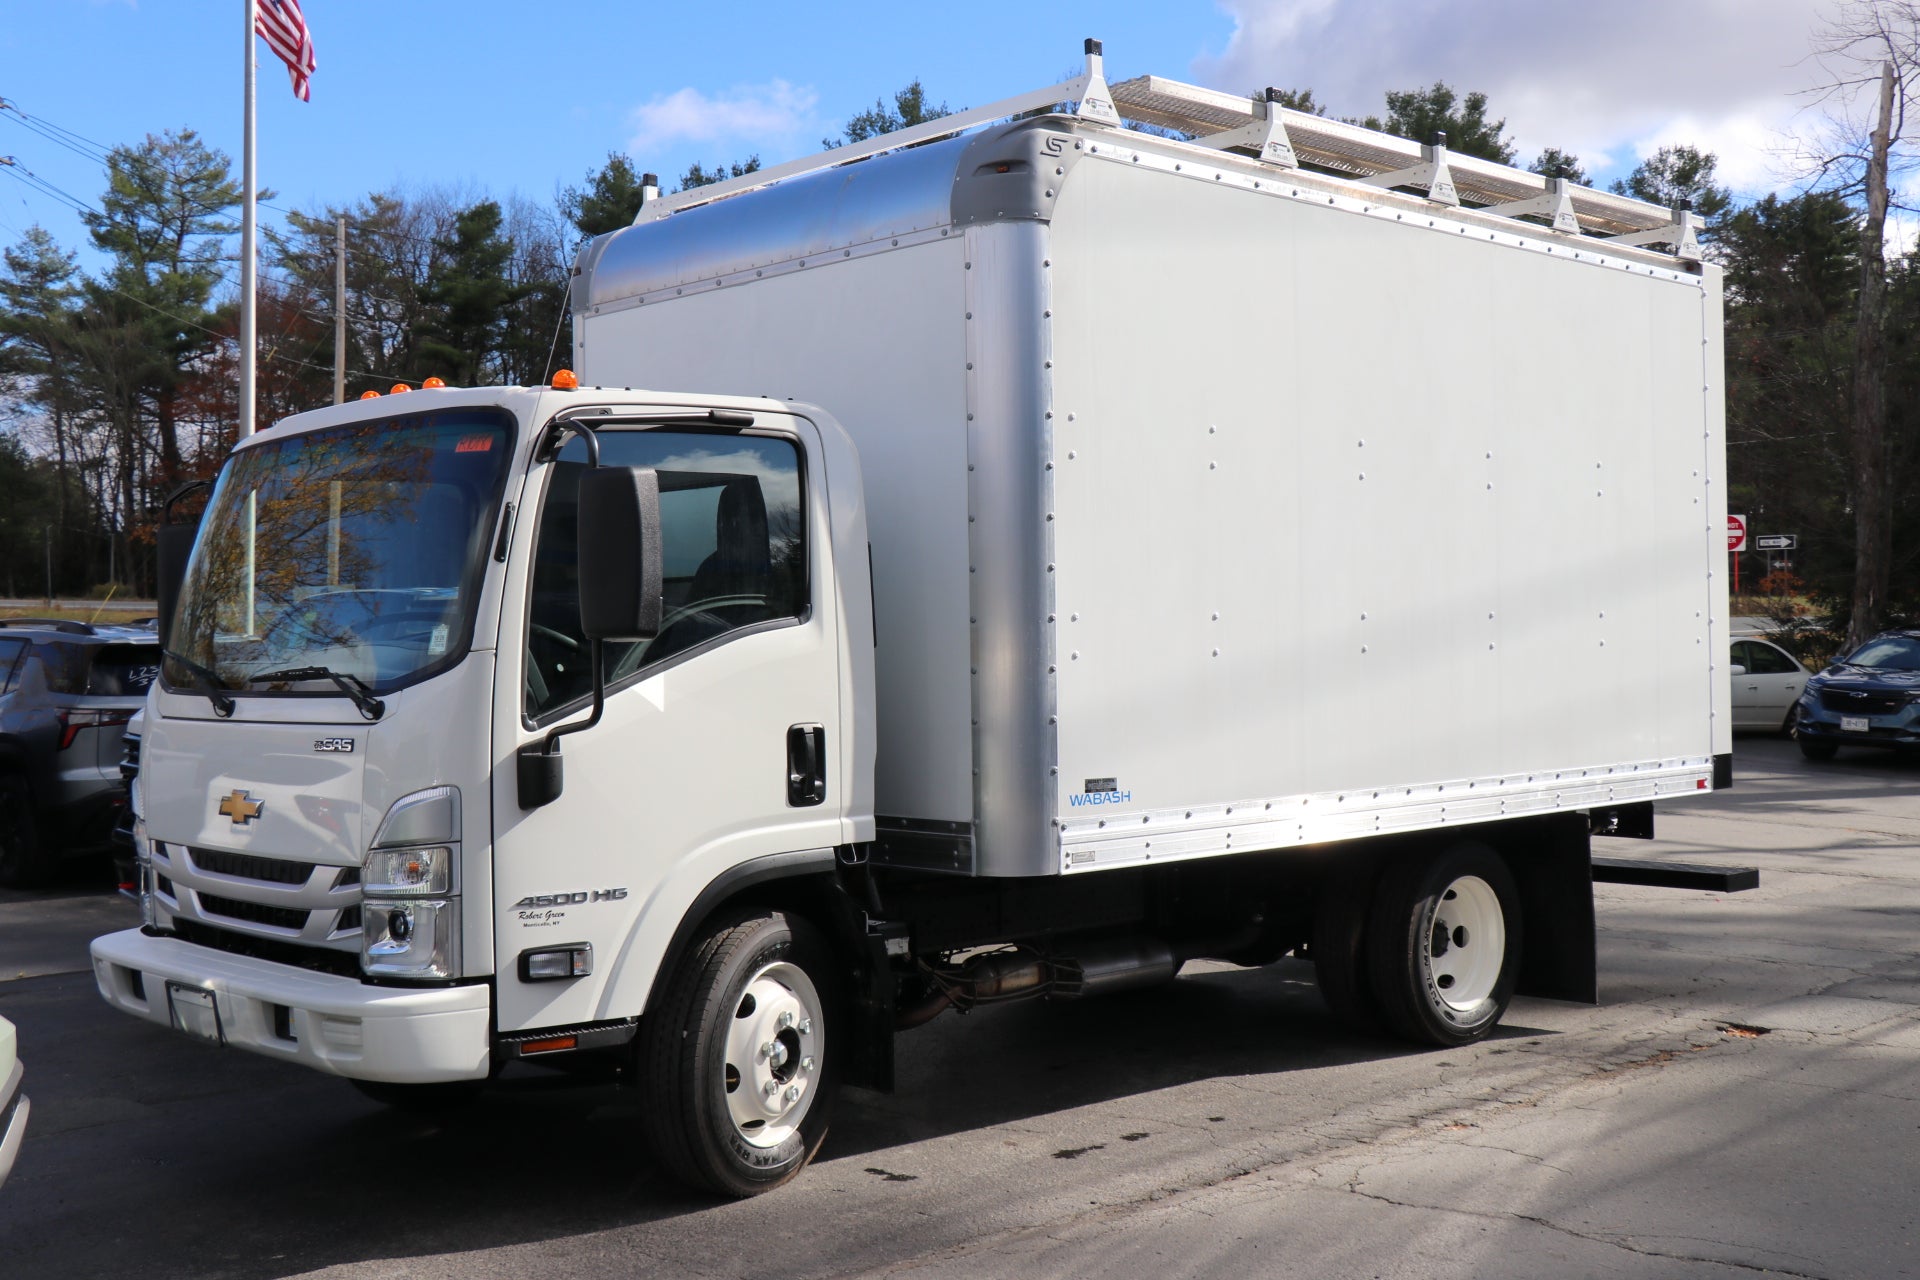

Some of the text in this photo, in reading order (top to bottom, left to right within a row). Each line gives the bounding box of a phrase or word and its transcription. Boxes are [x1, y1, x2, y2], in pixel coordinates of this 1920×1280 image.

[1070, 790, 1131, 807] WABASH
[516, 887, 628, 907] 4500 HG
[518, 910, 565, 921] Robert Green
